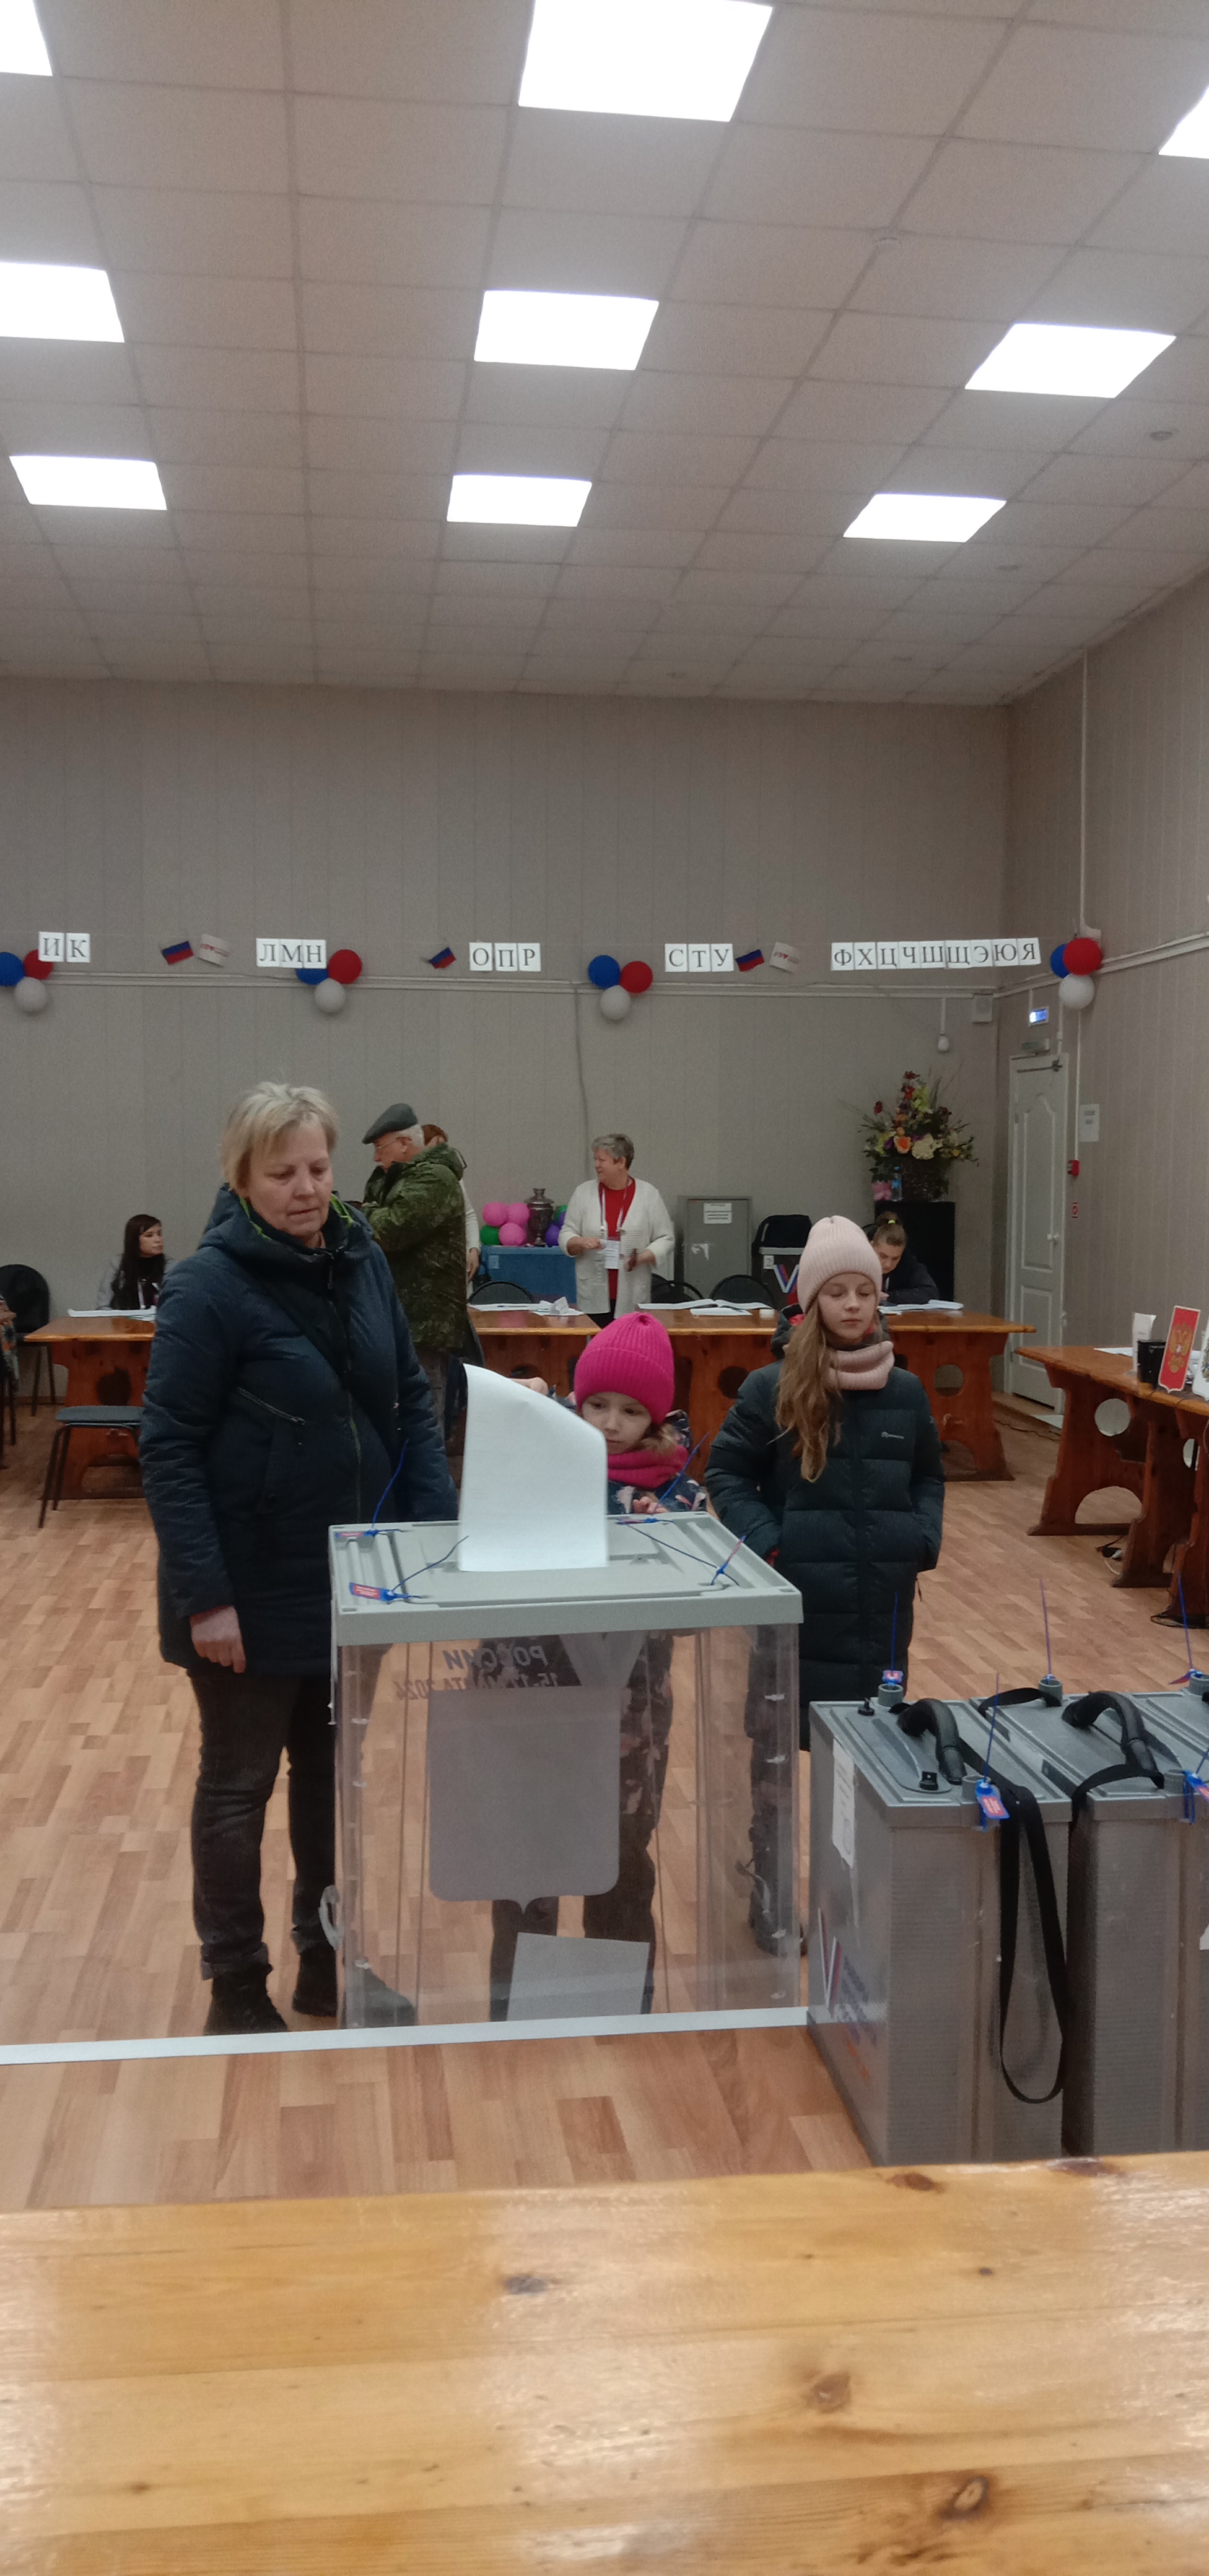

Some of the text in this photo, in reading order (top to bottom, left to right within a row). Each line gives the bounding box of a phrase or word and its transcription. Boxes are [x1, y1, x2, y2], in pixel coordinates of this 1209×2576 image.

[259, 944, 322, 962] ЛМН
[473, 947, 536, 967] ОПР
[669, 949, 730, 968] СТУ
[834, 942, 1036, 966] ФХЦЧШЩЭЮЯ
